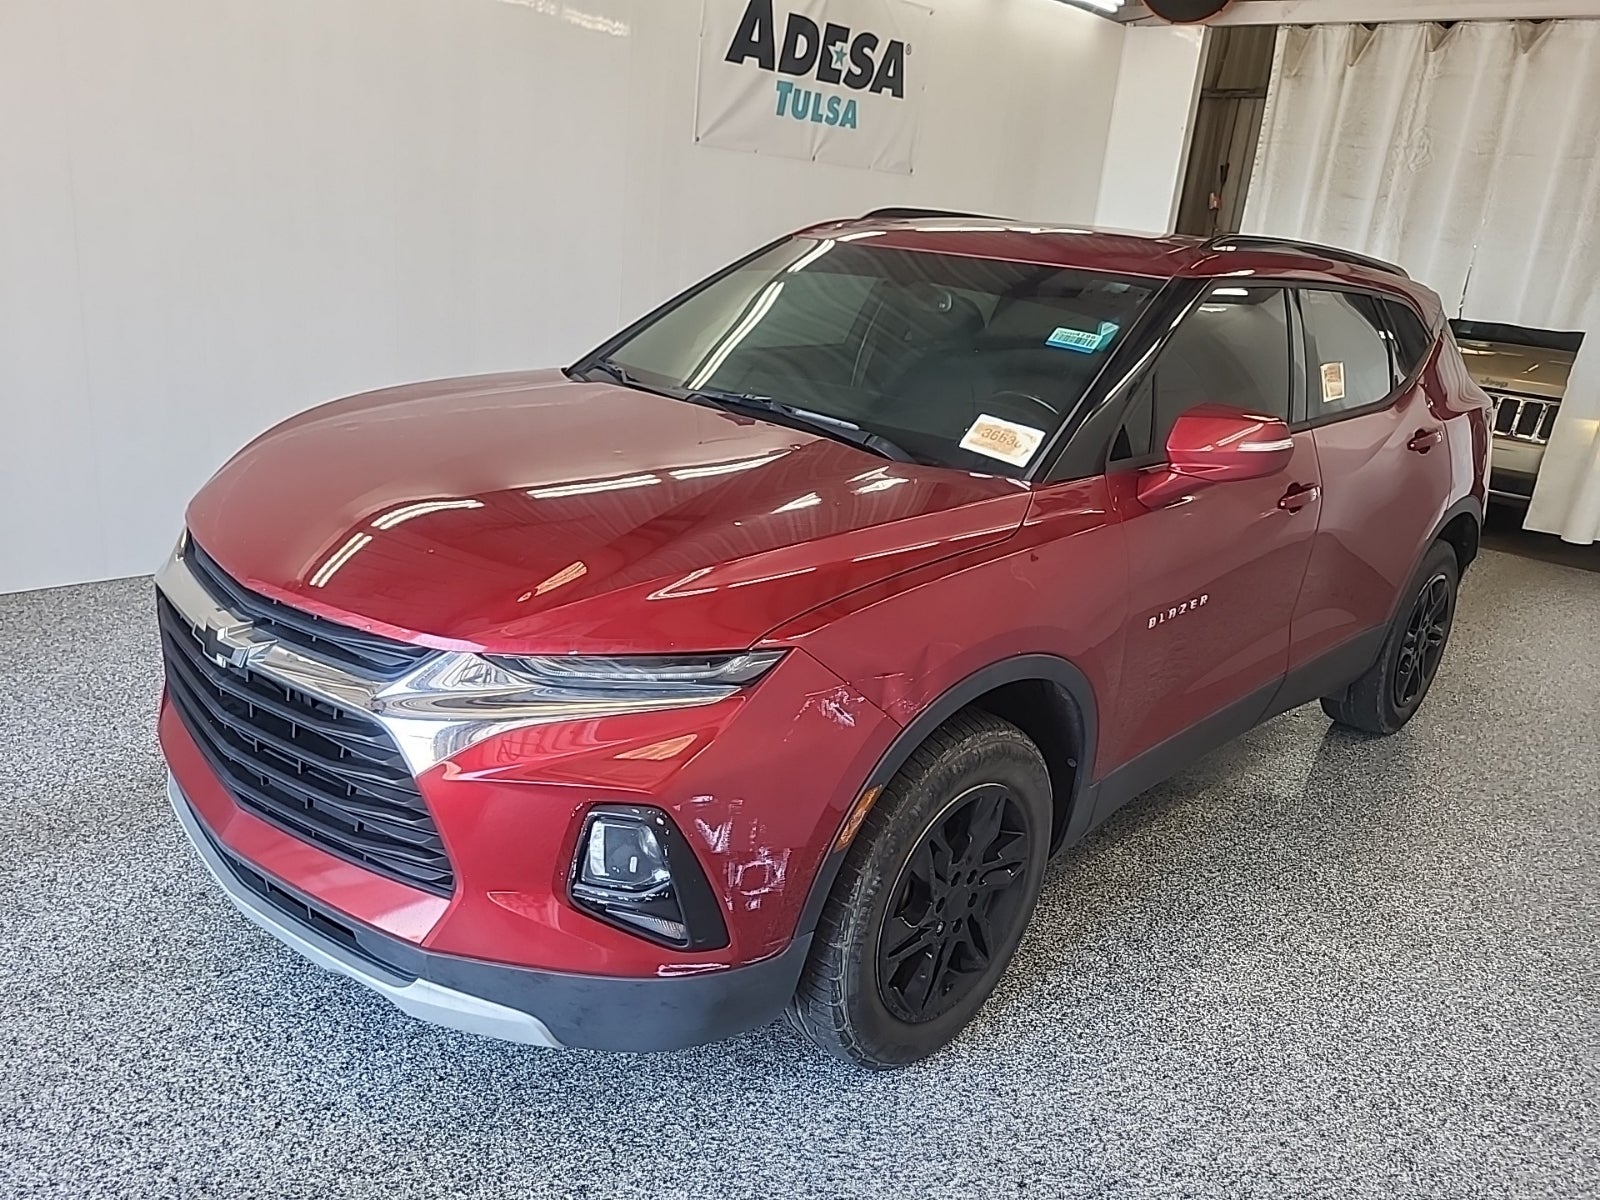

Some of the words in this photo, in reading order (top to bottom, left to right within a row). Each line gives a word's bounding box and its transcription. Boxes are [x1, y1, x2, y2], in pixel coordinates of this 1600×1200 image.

[725, 0, 904, 99] ADESA
[776, 80, 857, 129] TULSA
[1148, 594, 1209, 629] BLAZER
